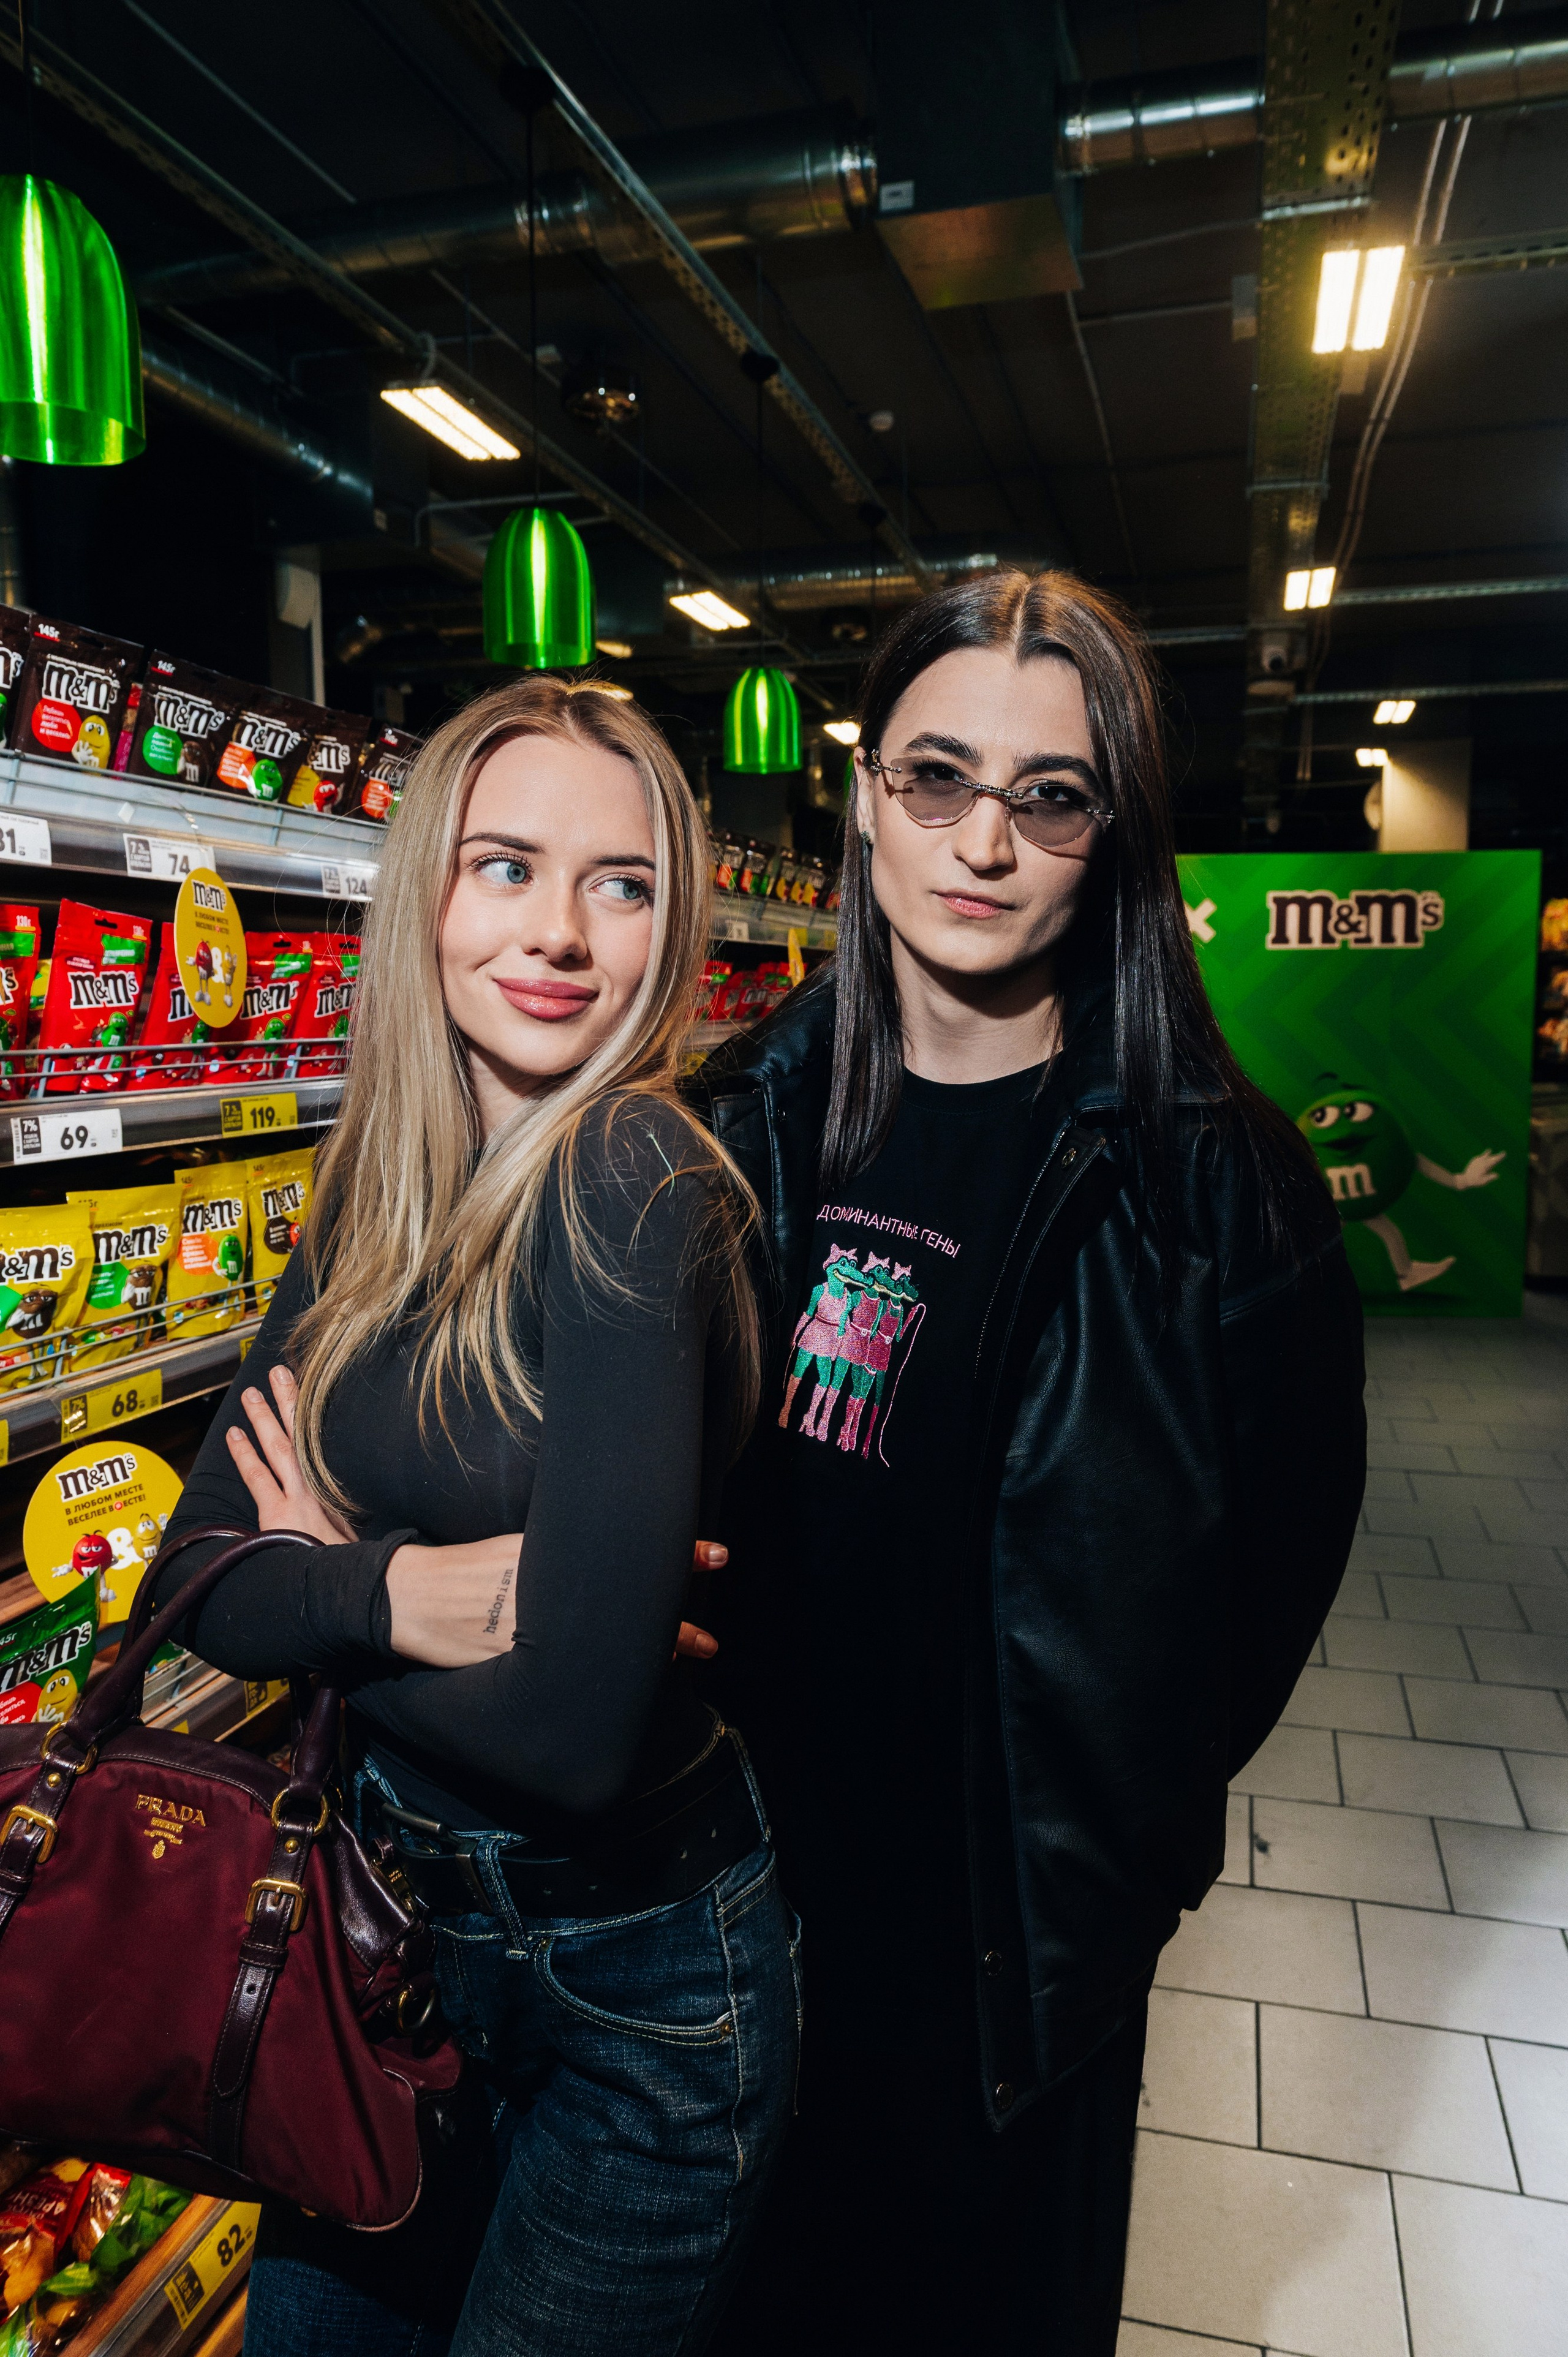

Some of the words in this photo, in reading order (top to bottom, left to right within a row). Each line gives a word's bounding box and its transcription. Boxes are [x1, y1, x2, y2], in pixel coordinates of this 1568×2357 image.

[168, 853, 190, 875] 74
[345, 877, 367, 894] 124
[1268, 891, 1444, 949] m&m's
[67, 971, 139, 1009] m&m's
[23, 1120, 38, 1133] 7%
[250, 1106, 275, 1128] 119
[61, 1125, 88, 1150] 69
[183, 1198, 243, 1236] m&m's
[816, 1204, 919, 1240] ДОМИНАНТНЫЕ
[920, 1228, 962, 1259] ГЕНЫ
[92, 1224, 168, 1265] m&m's
[0, 1245, 75, 1285] &m's
[112, 1389, 138, 1417] 68
[56, 1453, 137, 1501] m&m's
[65, 1507, 72, 1516] В
[74, 1493, 113, 1512] ЛЮБОМ
[115, 1484, 144, 1499] МЕСТЕ
[67, 1509, 107, 1526] ВЕСЕЛЕЕ
[108, 1493, 146, 1513] ВЕСТЕ!
[483, 1568, 514, 1634] hedonism
[135, 1793, 206, 1827] PRADA
[217, 2223, 246, 2268] 82
